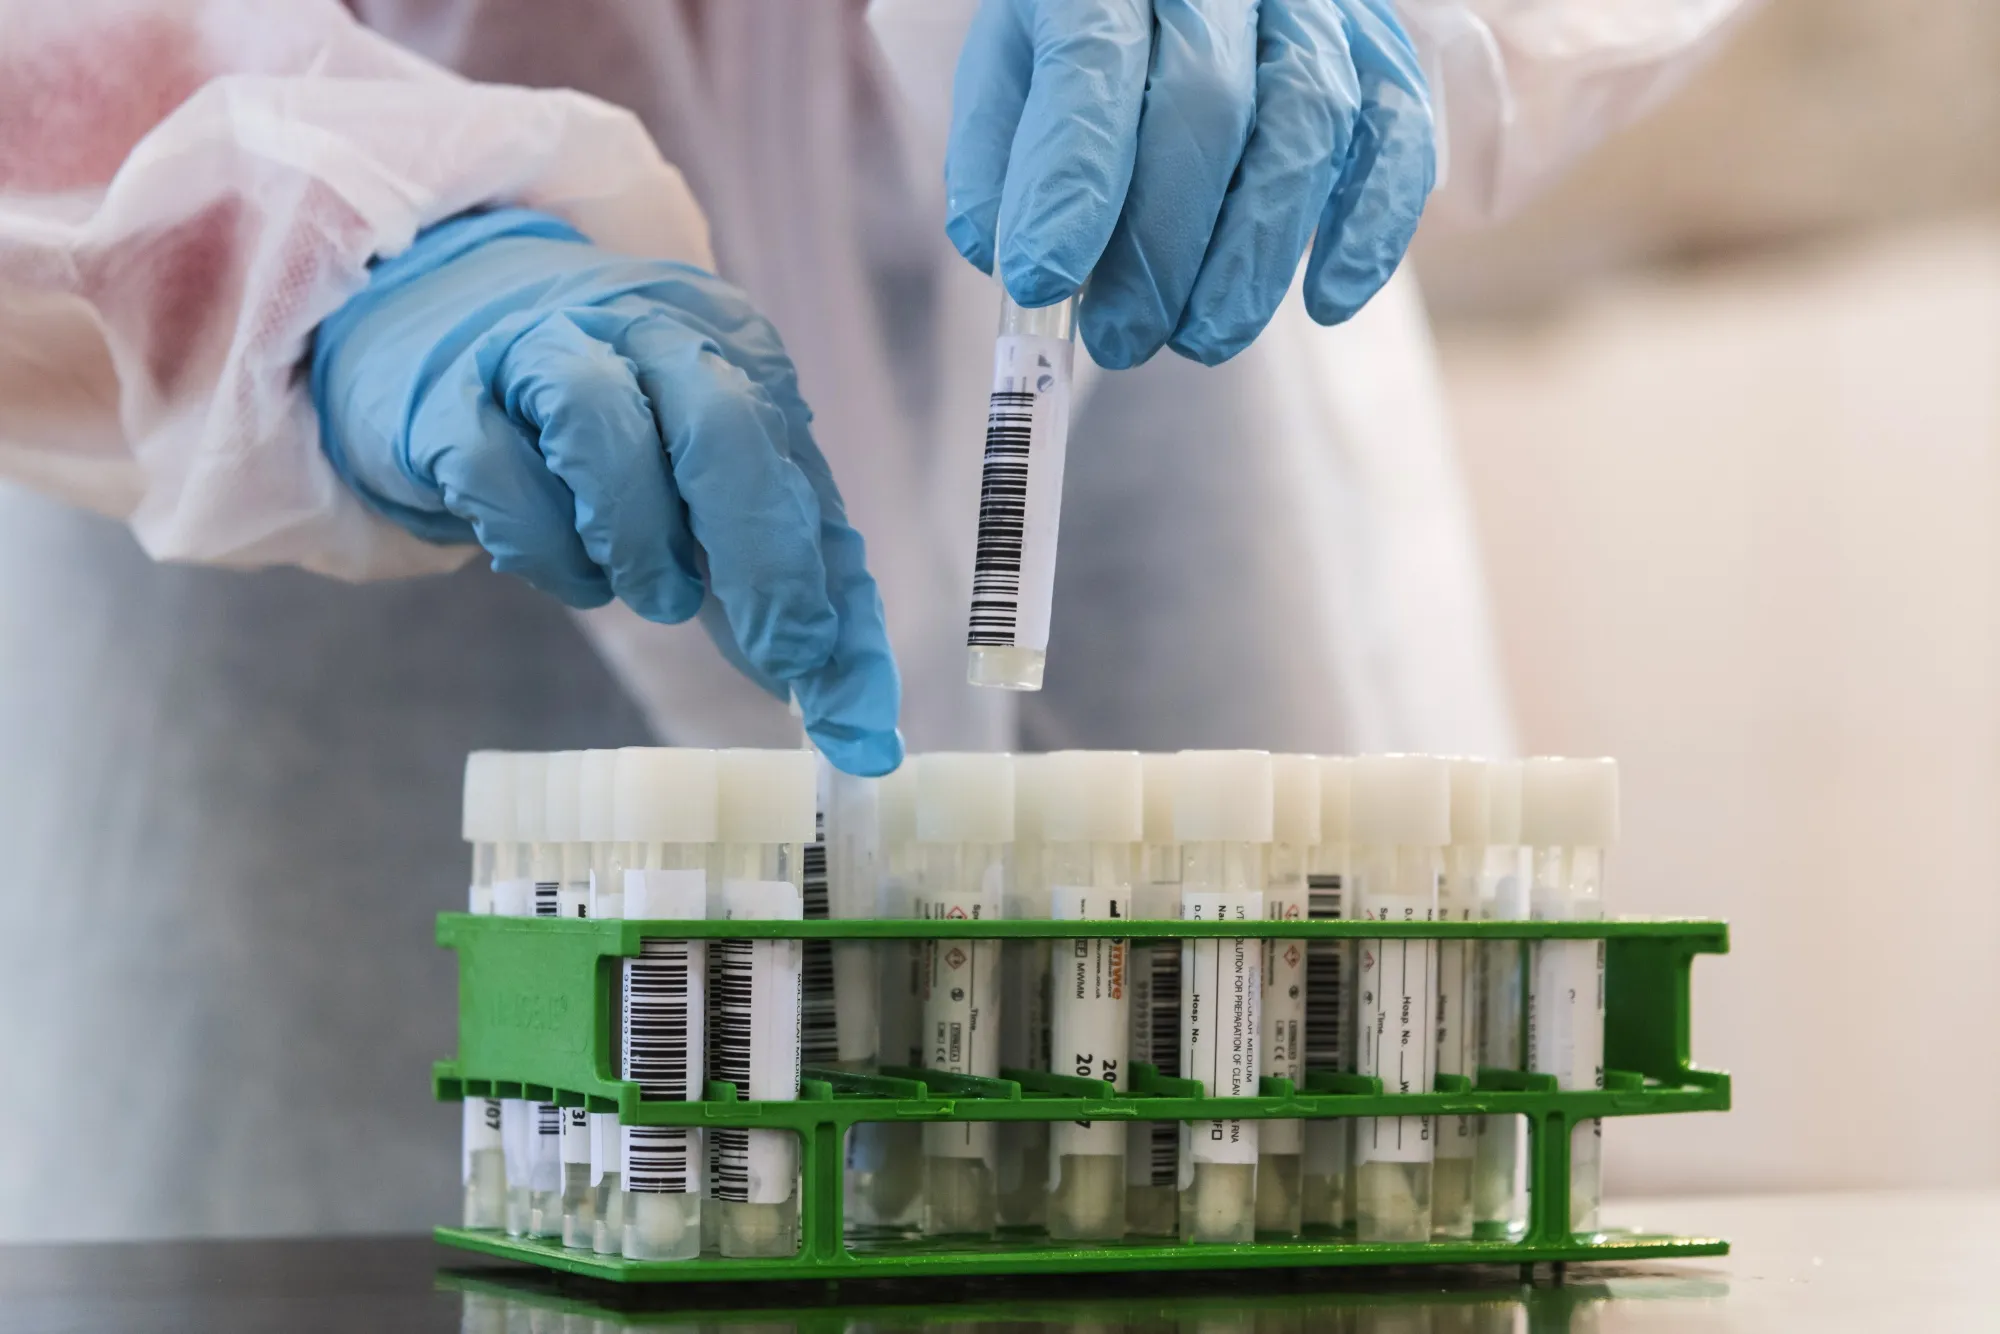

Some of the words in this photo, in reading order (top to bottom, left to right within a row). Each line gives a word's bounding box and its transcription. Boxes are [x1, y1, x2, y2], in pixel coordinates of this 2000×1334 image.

[1236, 905, 1246, 921] LYT
[1235, 937, 1245, 974] OLUTION
[1076, 962, 1086, 1000] MWMM
[1112, 945, 1125, 1001] mwe
[1234, 975, 1244, 994] FOR
[1190, 993, 1201, 1025] Hosp.
[1400, 996, 1412, 1028] Hosp.
[1232, 995, 1244, 1052] PREPARATION
[1376, 1011, 1387, 1036] Time
[1191, 1028, 1200, 1047] No.
[1401, 1030, 1411, 1048] No.
[1103, 1059, 1118, 1084] 20
[1232, 1053, 1243, 1066] OF
[1246, 1037, 1254, 1084] MEDIUM
[1231, 1067, 1242, 1096] CLEAN
[572, 1109, 587, 1127] 31
[1230, 1125, 1241, 1144] RNA
